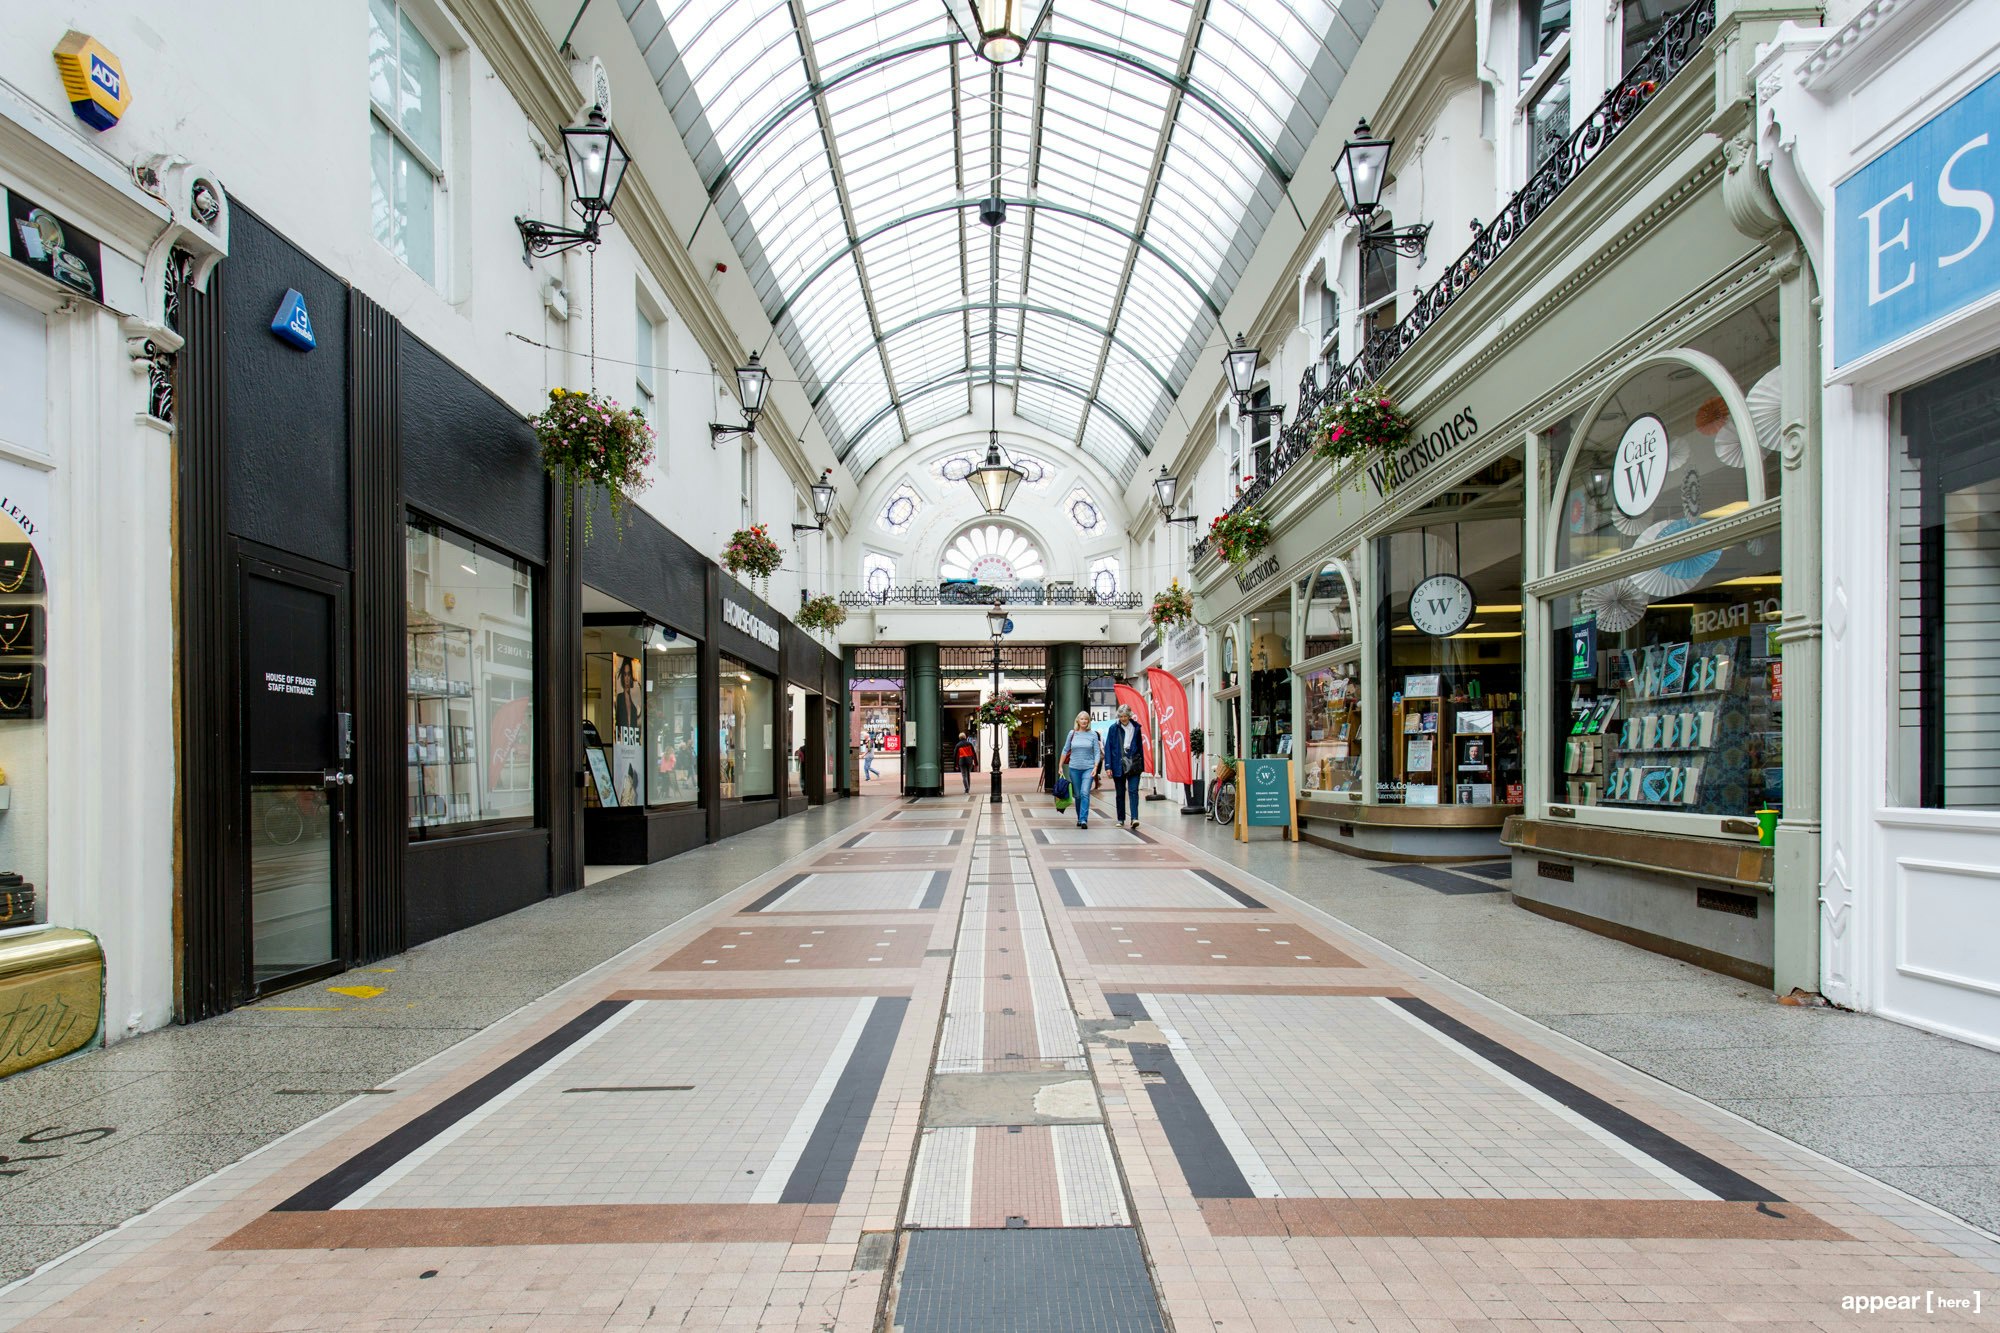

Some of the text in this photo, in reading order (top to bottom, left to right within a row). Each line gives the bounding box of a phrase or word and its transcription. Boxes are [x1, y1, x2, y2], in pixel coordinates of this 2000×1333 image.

[92, 63, 119, 93] ADT
[1858, 133, 1996, 307] ES
[290, 320, 312, 342] Chubb
[1622, 429, 1657, 464] Café
[1624, 454, 1656, 503] W
[1427, 597, 1453, 616] W
[265, 672, 317, 687] HOUSE OF FRASER
[267, 682, 315, 696] STAFF ENTRANCE
[1091, 711, 1108, 722] ALE
[615, 725, 640, 747] LIBRE
